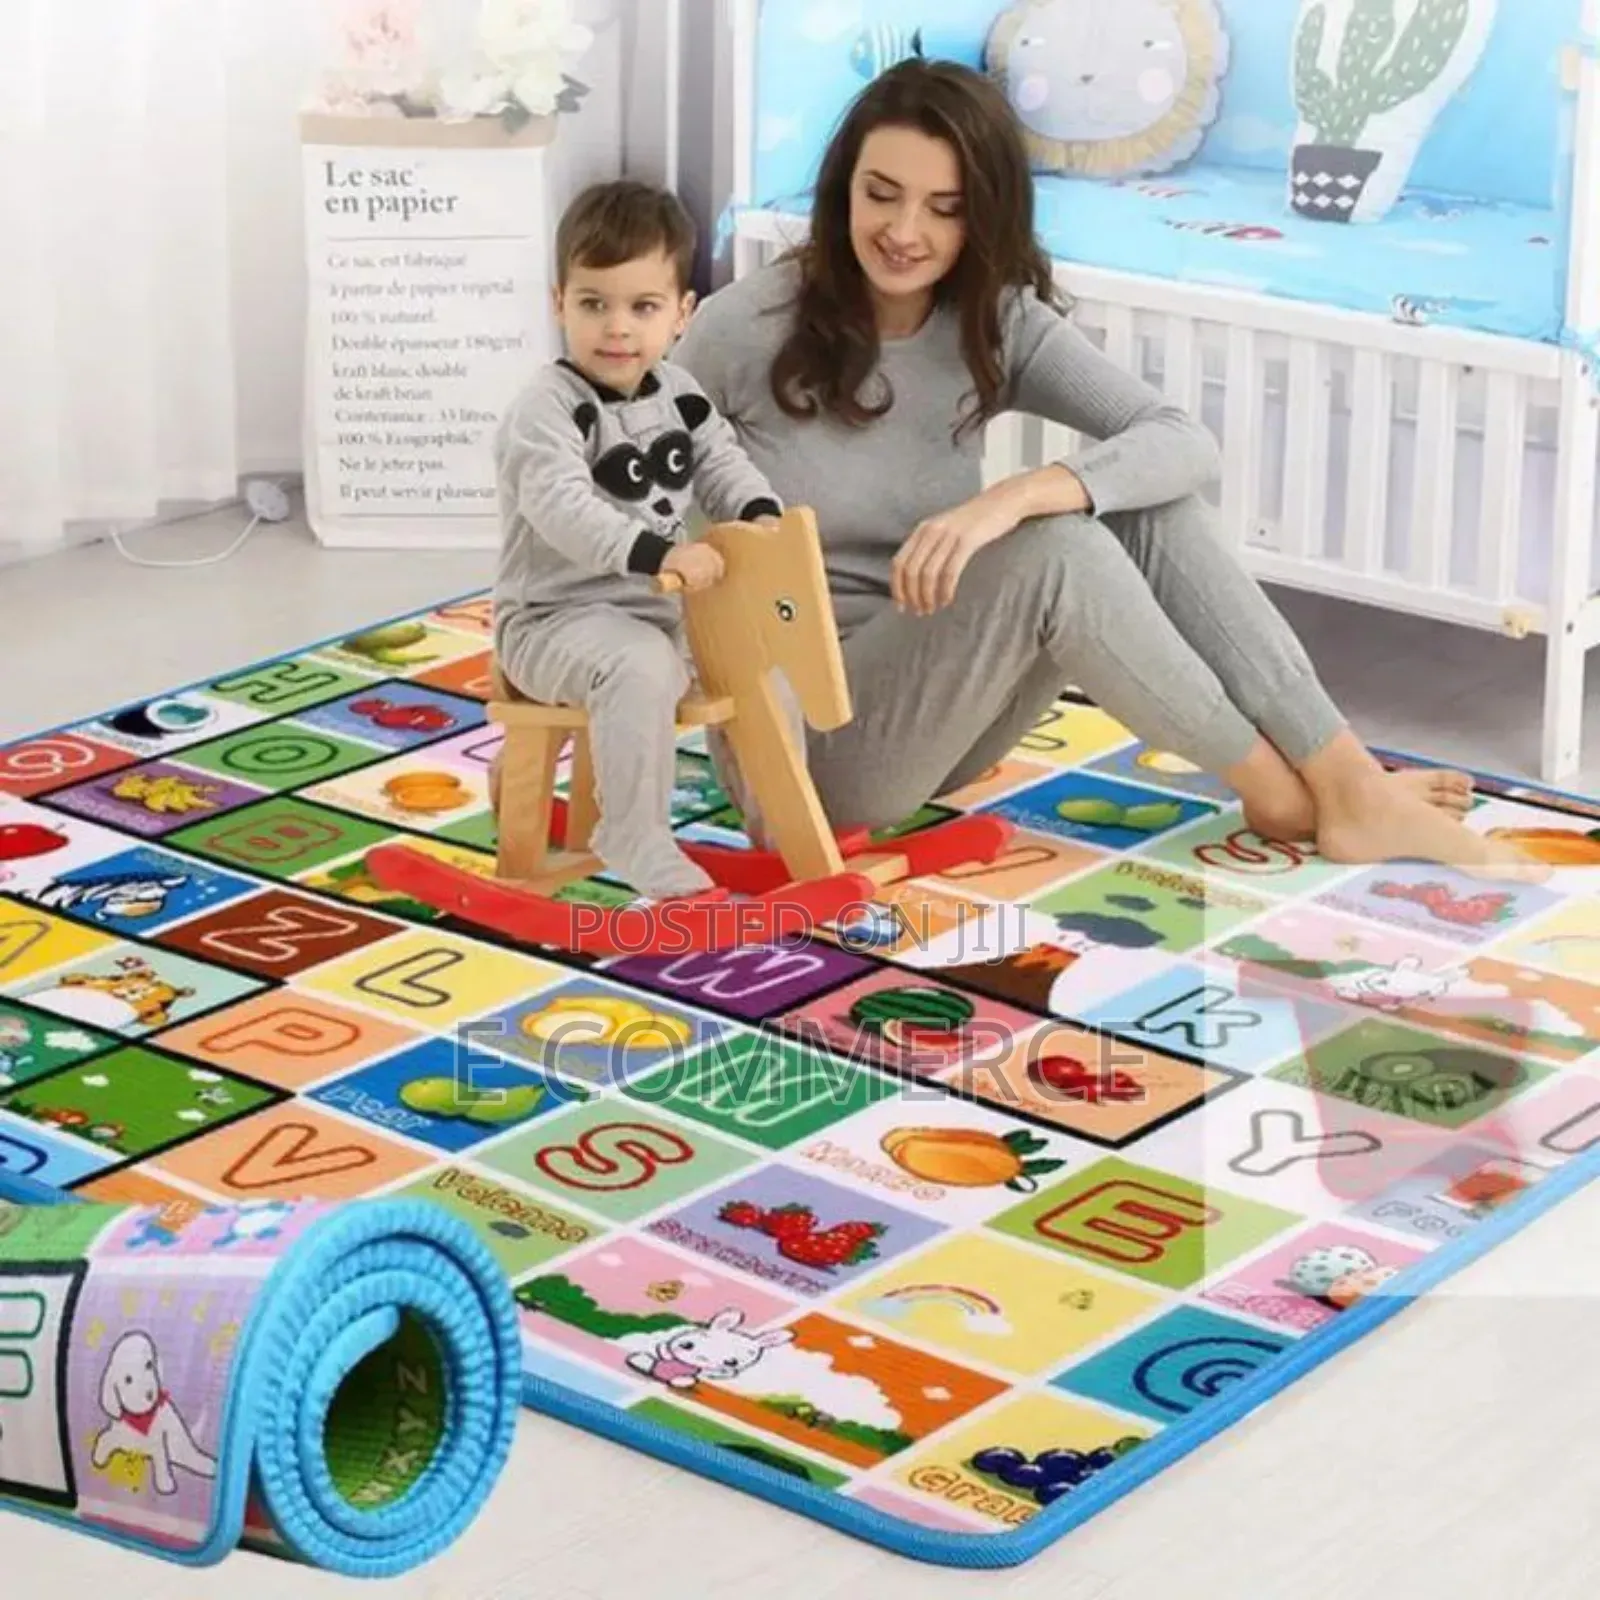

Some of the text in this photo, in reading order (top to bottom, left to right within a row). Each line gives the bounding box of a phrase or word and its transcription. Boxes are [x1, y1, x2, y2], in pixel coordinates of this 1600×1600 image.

[323, 160, 414, 188] Le sac
[324, 187, 460, 222] en papier
